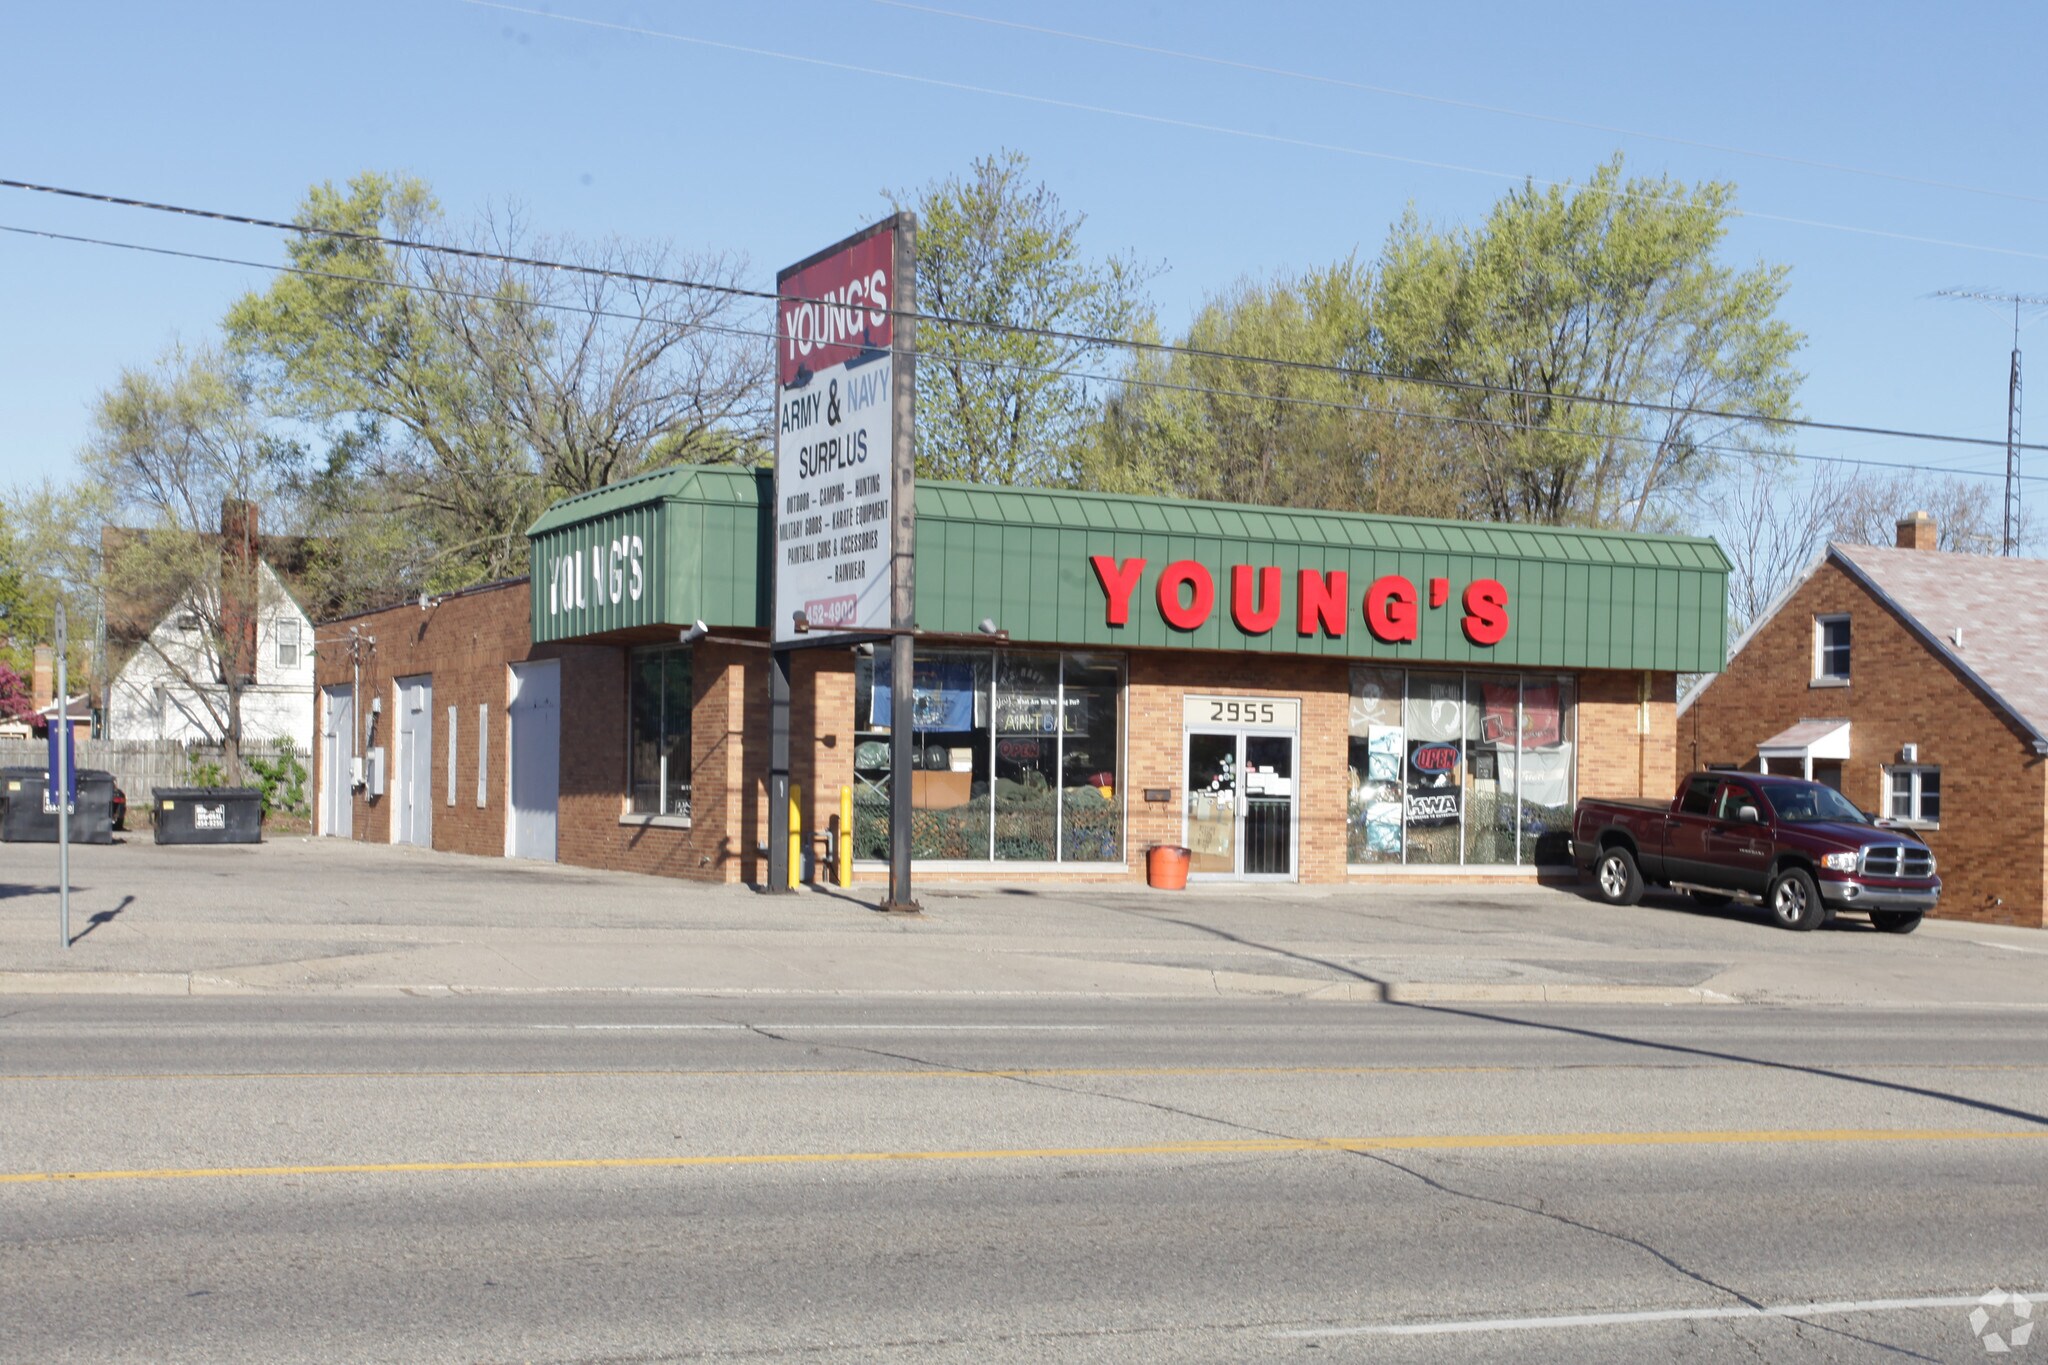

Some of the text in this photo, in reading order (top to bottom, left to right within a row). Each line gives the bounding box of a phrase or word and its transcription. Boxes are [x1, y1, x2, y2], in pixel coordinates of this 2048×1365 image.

[785, 268, 888, 361] YOUNG'S
[780, 366, 890, 435] ARMY & NAVY
[798, 428, 868, 480] SURPLUS
[786, 492, 810, 515] OUTDOOR
[819, 483, 845, 507] CAMPING
[855, 474, 881, 498] HUNTING
[779, 519, 803, 542] MILITARY
[805, 515, 823, 538] GOODS
[832, 508, 853, 531] KARATE
[856, 499, 889, 528] EQUIPMENT
[787, 531, 879, 565] PAINTBALL GUNS & ACCESSORIES
[549, 535, 644, 616] YOUNG'S
[835, 560, 866, 584] RAINWEAR
[1089, 555, 1510, 648] YOUNG'S
[1210, 702, 1274, 723] 2955
[1417, 748, 1457, 769] OPEN
[1406, 794, 1458, 816] KWA
